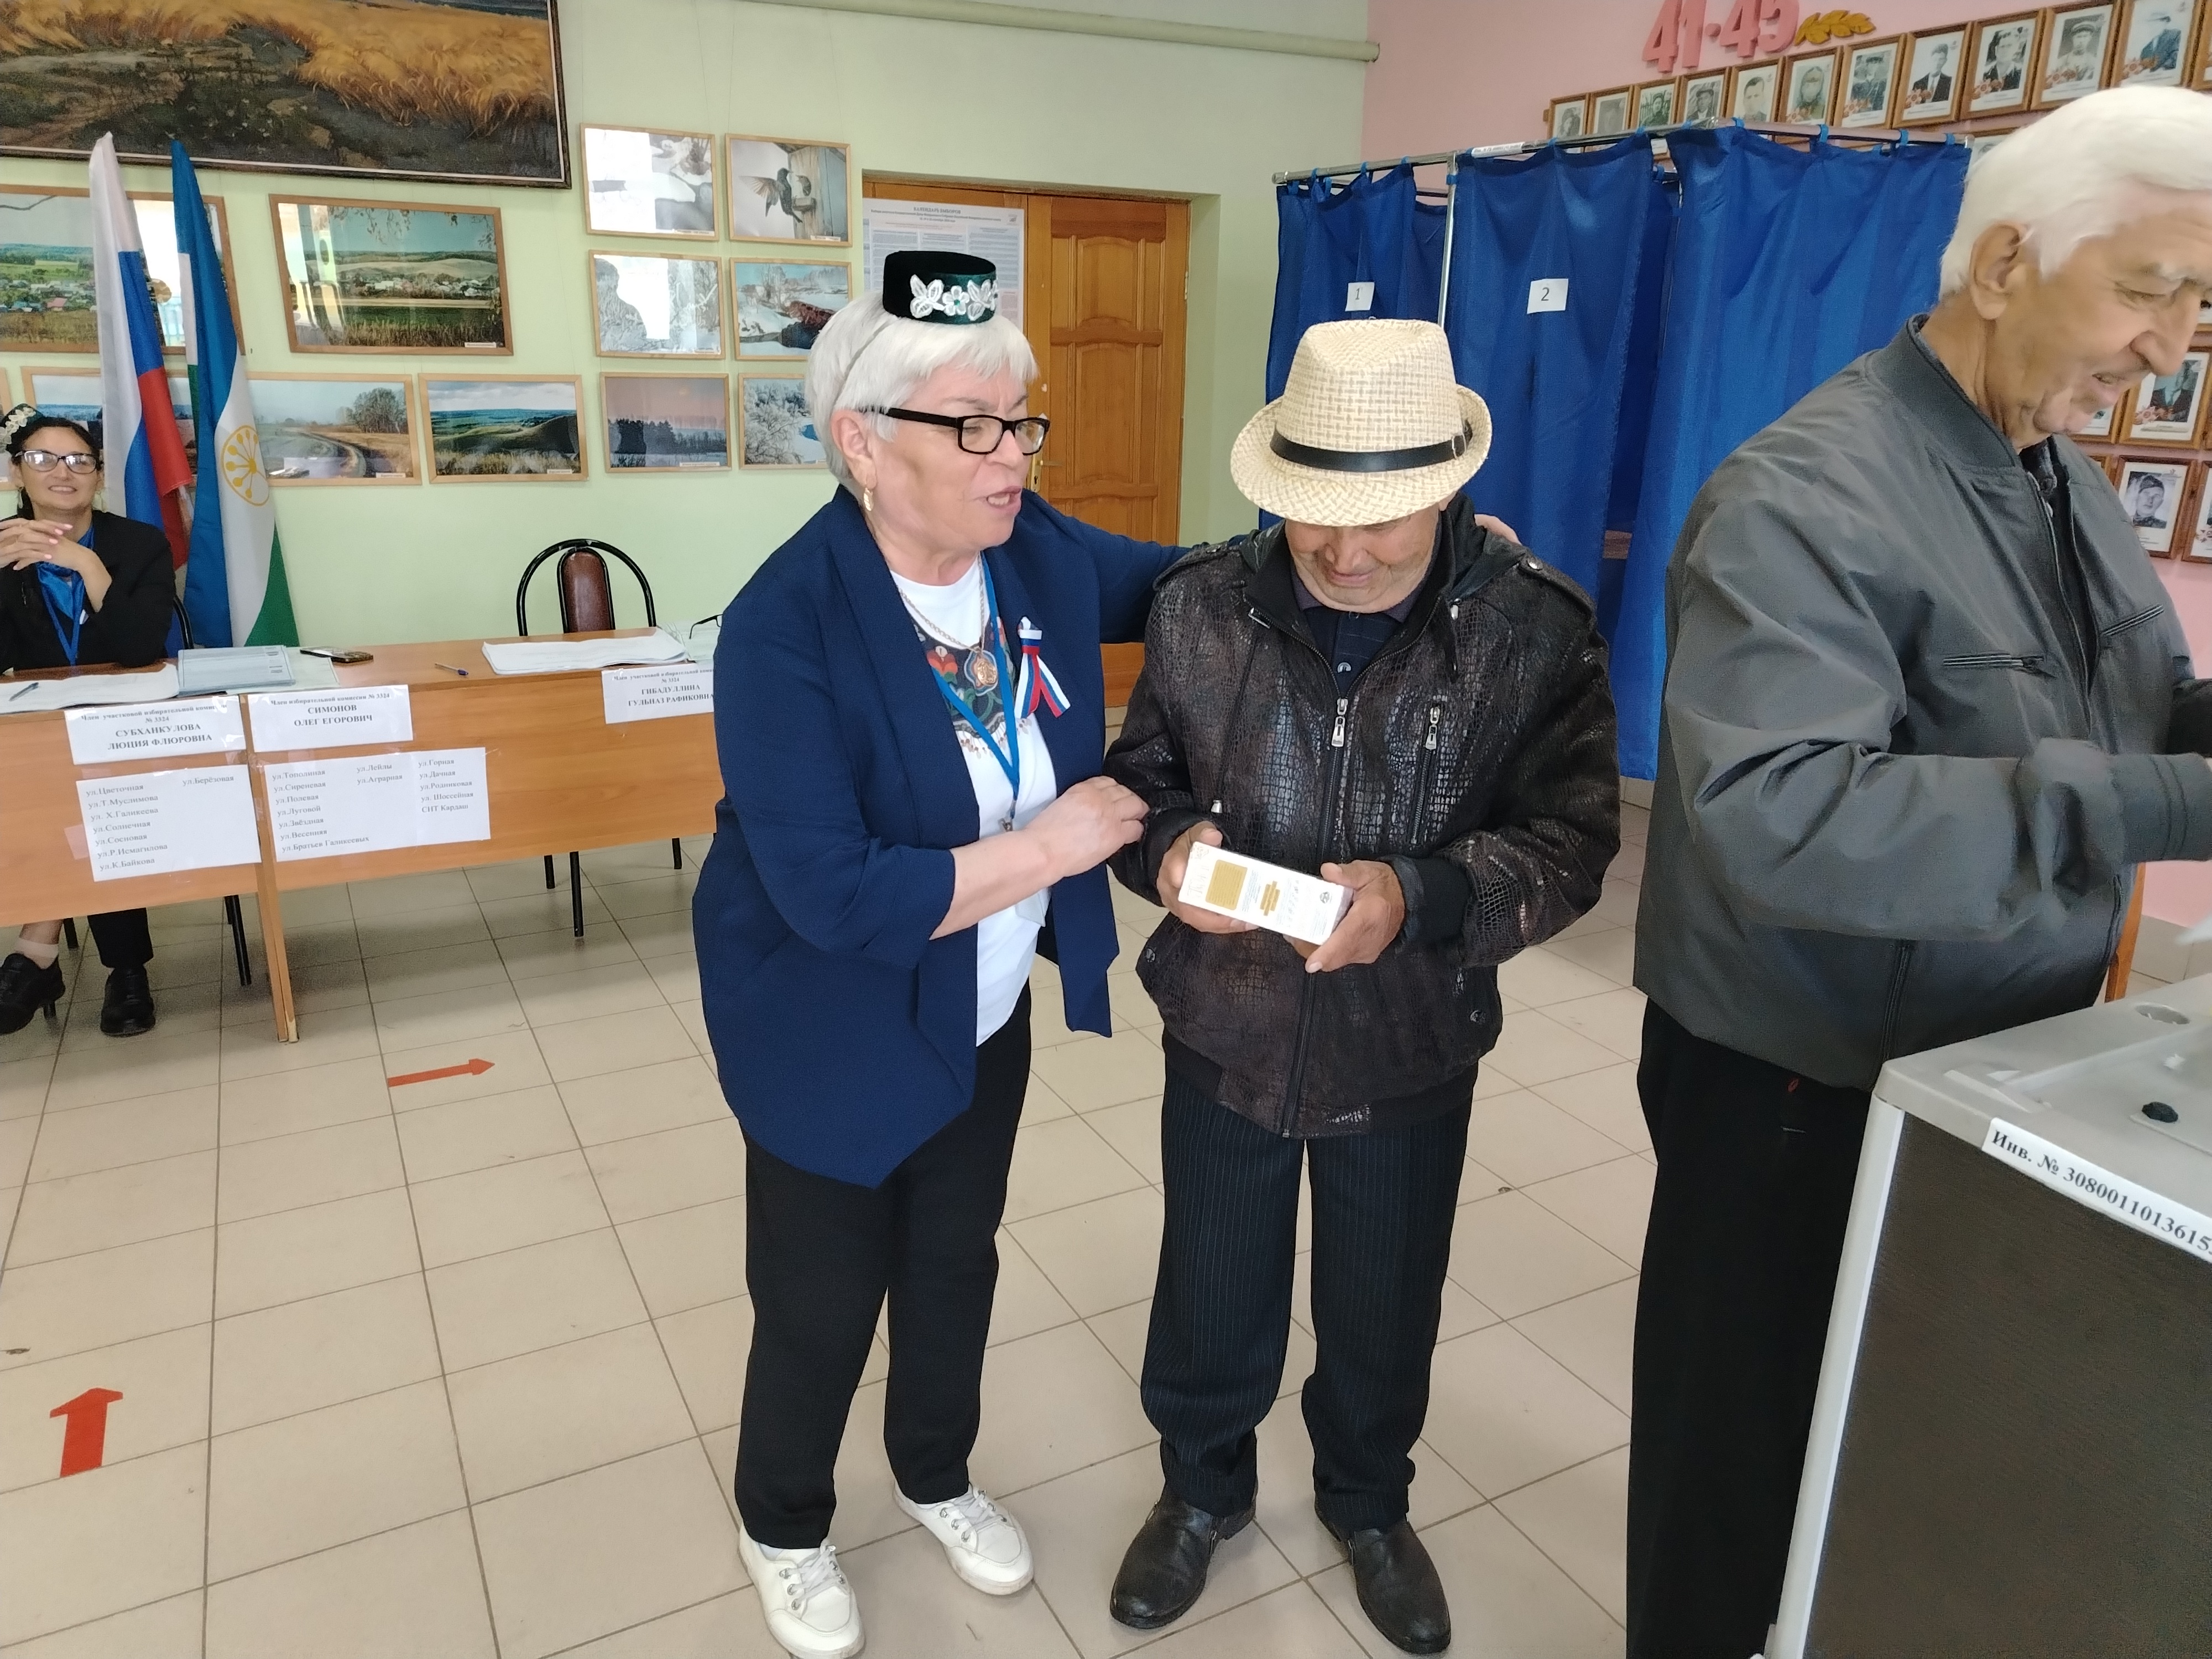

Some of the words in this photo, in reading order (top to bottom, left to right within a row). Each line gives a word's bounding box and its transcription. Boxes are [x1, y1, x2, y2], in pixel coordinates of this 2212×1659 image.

[1355, 288, 1360, 300] 1
[1541, 286, 1550, 302] 2
[641, 684, 700, 695] ГИБАДУЛЛИНА
[289, 696, 336, 705] избирательной
[628, 697, 665, 707] ГУЛЬНАЗ
[307, 705, 357, 714] СИМОНОВ
[103, 710, 143, 721] участковой
[294, 718, 320, 727] ОЛЕГ
[322, 714, 373, 725] ЕГОРОВИЧ
[115, 723, 201, 737] СУБХАНКУЛОВА
[108, 739, 149, 750] ЛЮЦИЯ
[151, 734, 212, 746] ФЛЮРОВНА
[418, 759, 455, 768] ул.Горная
[182, 775, 234, 786] ул.Берёзовая
[272, 769, 325, 781] ул.Тополиная
[357, 774, 403, 785] ул.Аграрная
[419, 770, 456, 780] ул.Дачная
[86, 784, 144, 797] ул.Цветочная
[274, 781, 326, 793] ул.Сиреневая
[420, 781, 472, 791] ул.Родниковая
[275, 795, 319, 805] ул.Полевая
[434, 792, 474, 800] Шоссейная
[88, 795, 159, 809] ул.Т.Муслимова
[441, 804, 469, 812] Кардаш
[93, 821, 151, 834] ул.Солнечная
[279, 818, 324, 829] ул.Звёздная
[95, 833, 148, 847] ул.Сосновая
[280, 830, 327, 841] ул.Весенняя
[282, 842, 323, 853] ул.Братьев
[325, 837, 369, 846] Галикеевых
[97, 844, 168, 859] ул.Р.Исмагилова
[100, 858, 155, 872] ул.К.Байкова
[1991, 1129, 2032, 1162] Инв.
[2037, 1154, 2060, 1175] №
